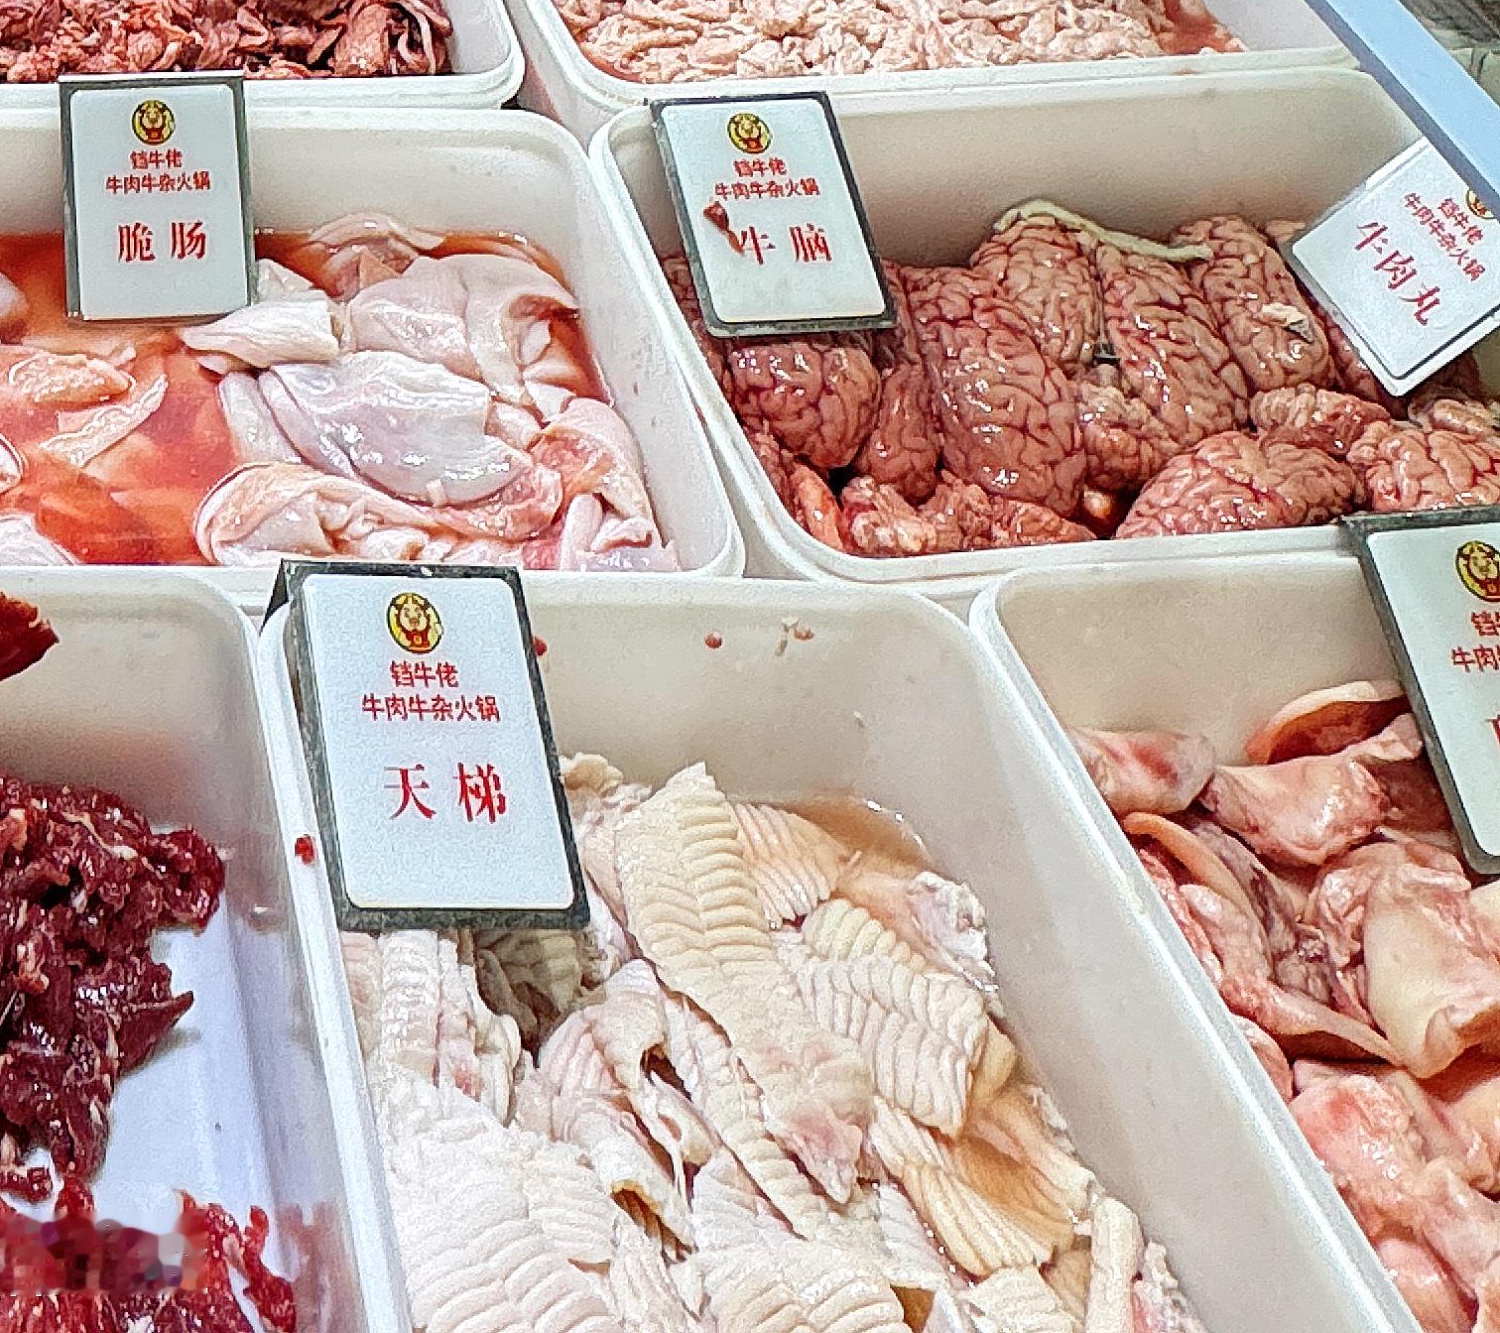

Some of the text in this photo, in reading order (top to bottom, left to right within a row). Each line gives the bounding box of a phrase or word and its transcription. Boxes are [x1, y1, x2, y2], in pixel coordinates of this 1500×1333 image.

[117, 220, 207, 263] 脆肠
[733, 222, 833, 266] 牛脑
[1353, 221, 1441, 326] 牛肉丸
[1471, 610, 1500, 638] 铛
[390, 660, 459, 689] 铛牛佬
[1451, 644, 1500, 674] 牛肉
[362, 693, 501, 722] 牛肉牛杂火锅
[382, 762, 508, 823] 天梯
